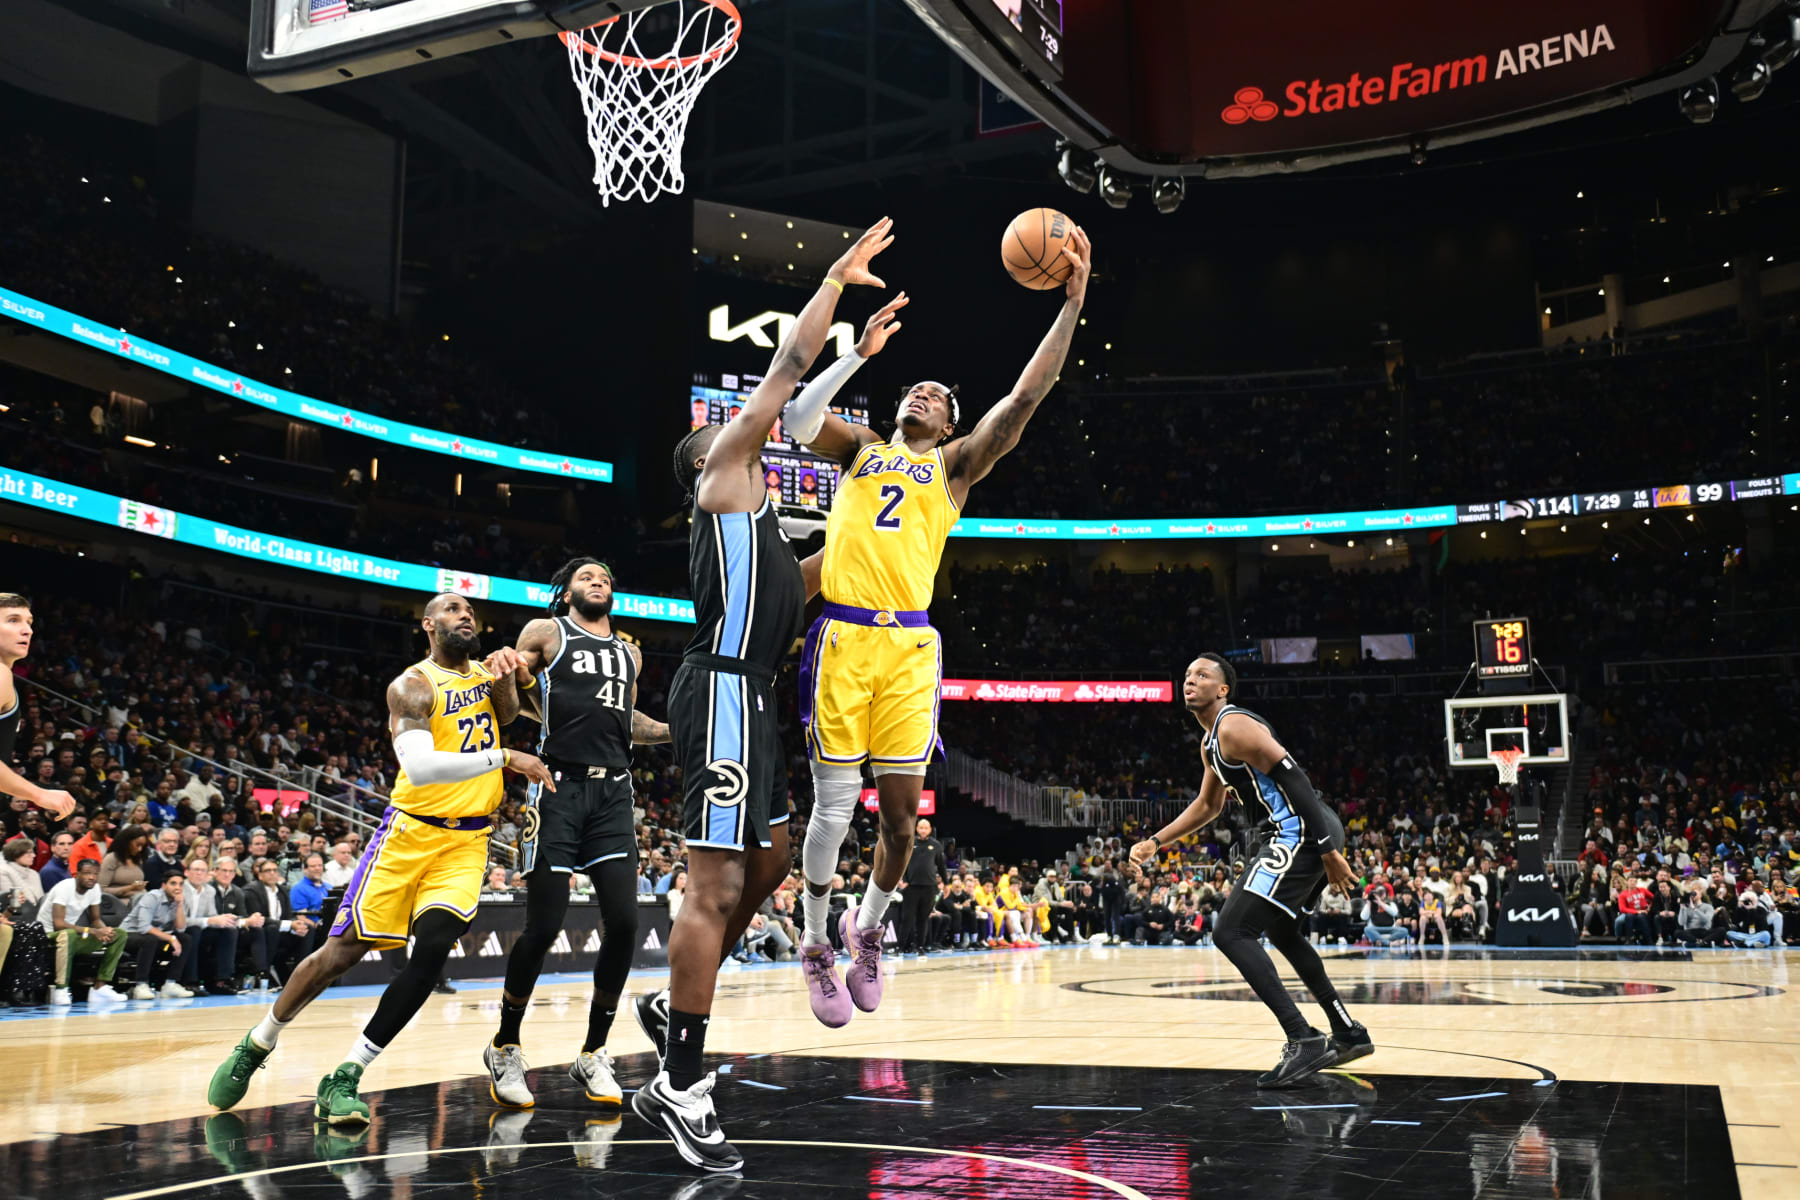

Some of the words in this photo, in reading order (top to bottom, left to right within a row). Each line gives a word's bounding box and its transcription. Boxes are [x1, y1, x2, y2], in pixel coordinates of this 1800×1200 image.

[1494, 24, 1616, 79] ARENA
[2, 299, 46, 322] SILVER
[133, 346, 170, 367] SILVER
[245, 386, 278, 405] SILVER
[355, 419, 388, 436] SILVER
[852, 453, 935, 485] LAKERS
[1696, 483, 1723, 502] 99
[1737, 488, 1773, 498] TIMEOUTS
[1748, 479, 1772, 488] FOULS
[31, 481, 78, 508] Beer
[1583, 494, 1621, 511] 7:29
[1634, 491, 1647, 500] 16
[874, 485, 905, 533] 2
[1468, 504, 1490, 513] FOULS
[1537, 497, 1572, 516] 114
[1632, 500, 1649, 509] 4TH
[1458, 513, 1491, 523] TIMEOUTS
[214, 527, 312, 564] World-Class
[317, 551, 359, 573] Light
[363, 561, 401, 581] Beer
[624, 598, 664, 616] Light
[1491, 622, 1523, 638] 7:29
[1496, 638, 1521, 663] 16
[572, 647, 628, 683] atl
[595, 680, 626, 712] 41
[457, 711, 496, 753] 23
